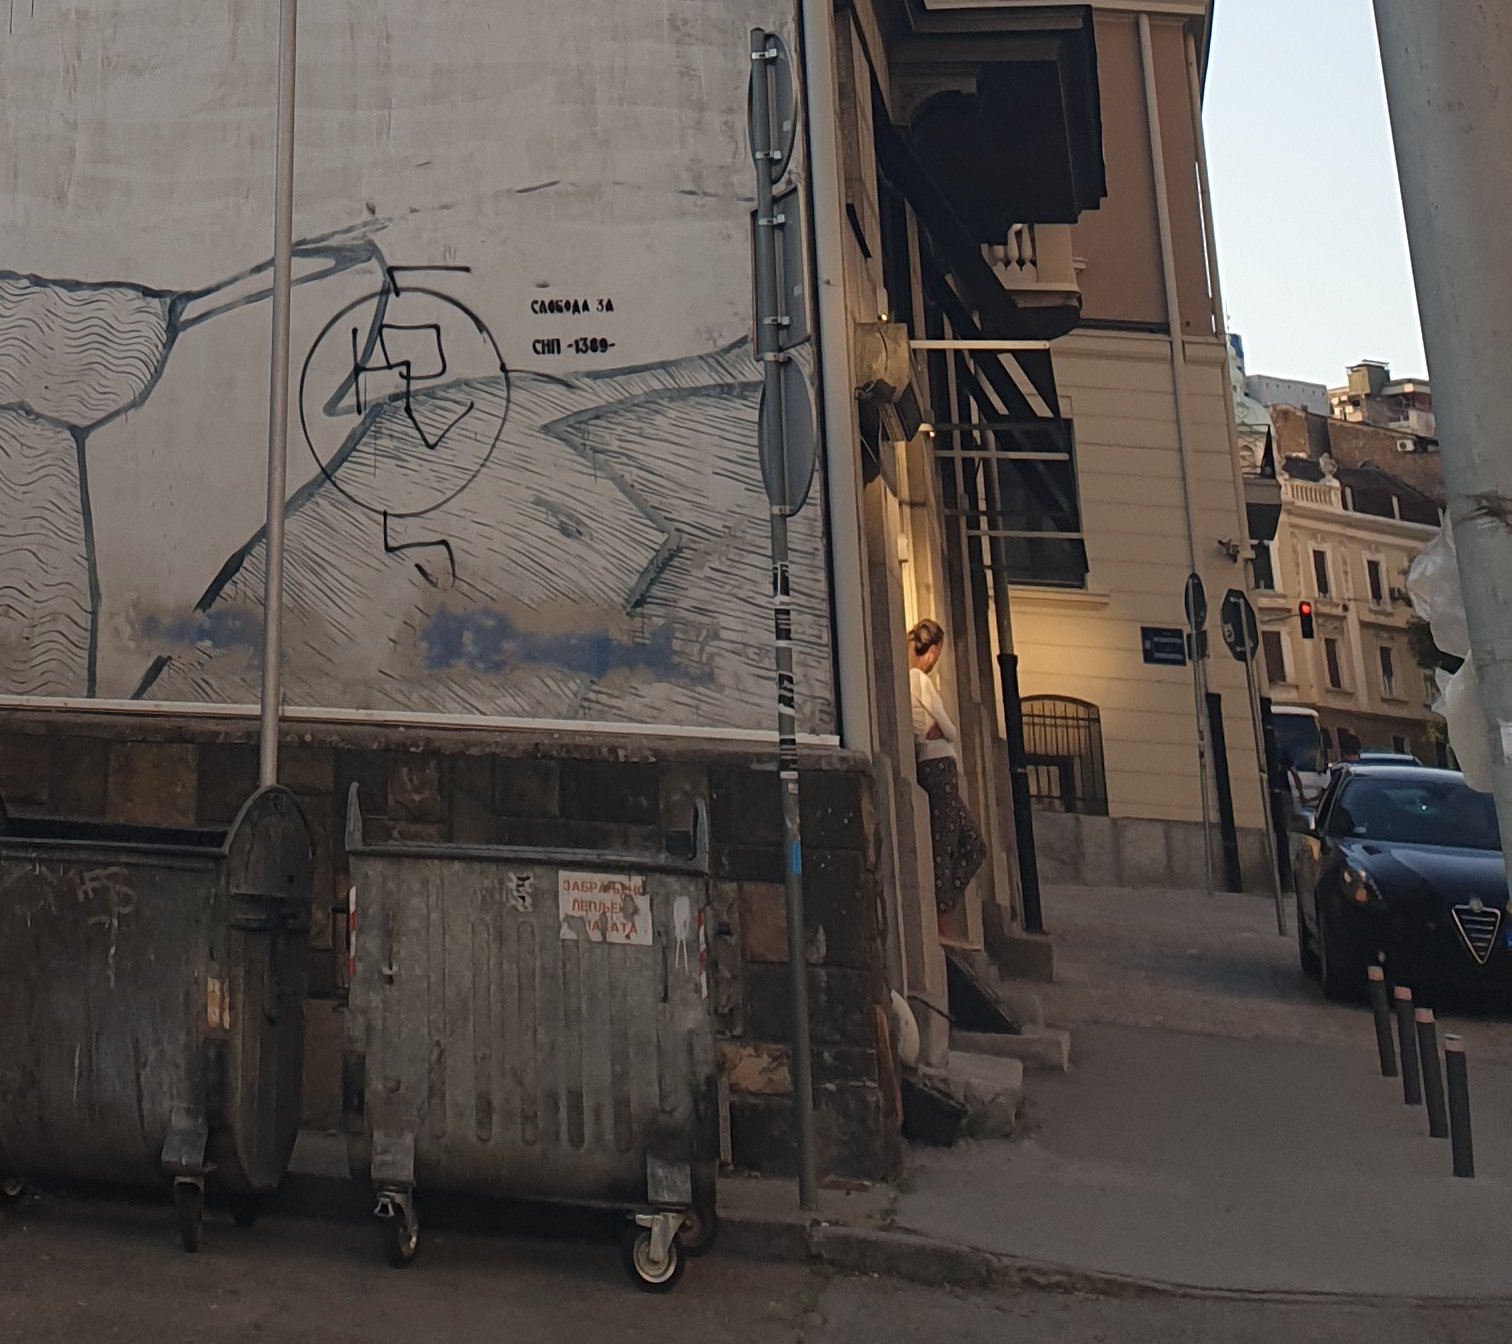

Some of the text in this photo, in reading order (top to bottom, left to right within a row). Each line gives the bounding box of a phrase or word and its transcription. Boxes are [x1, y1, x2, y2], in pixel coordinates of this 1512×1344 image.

[530, 297, 614, 316] СЛОБОДА ЗА
[532, 338, 562, 355] СНП
